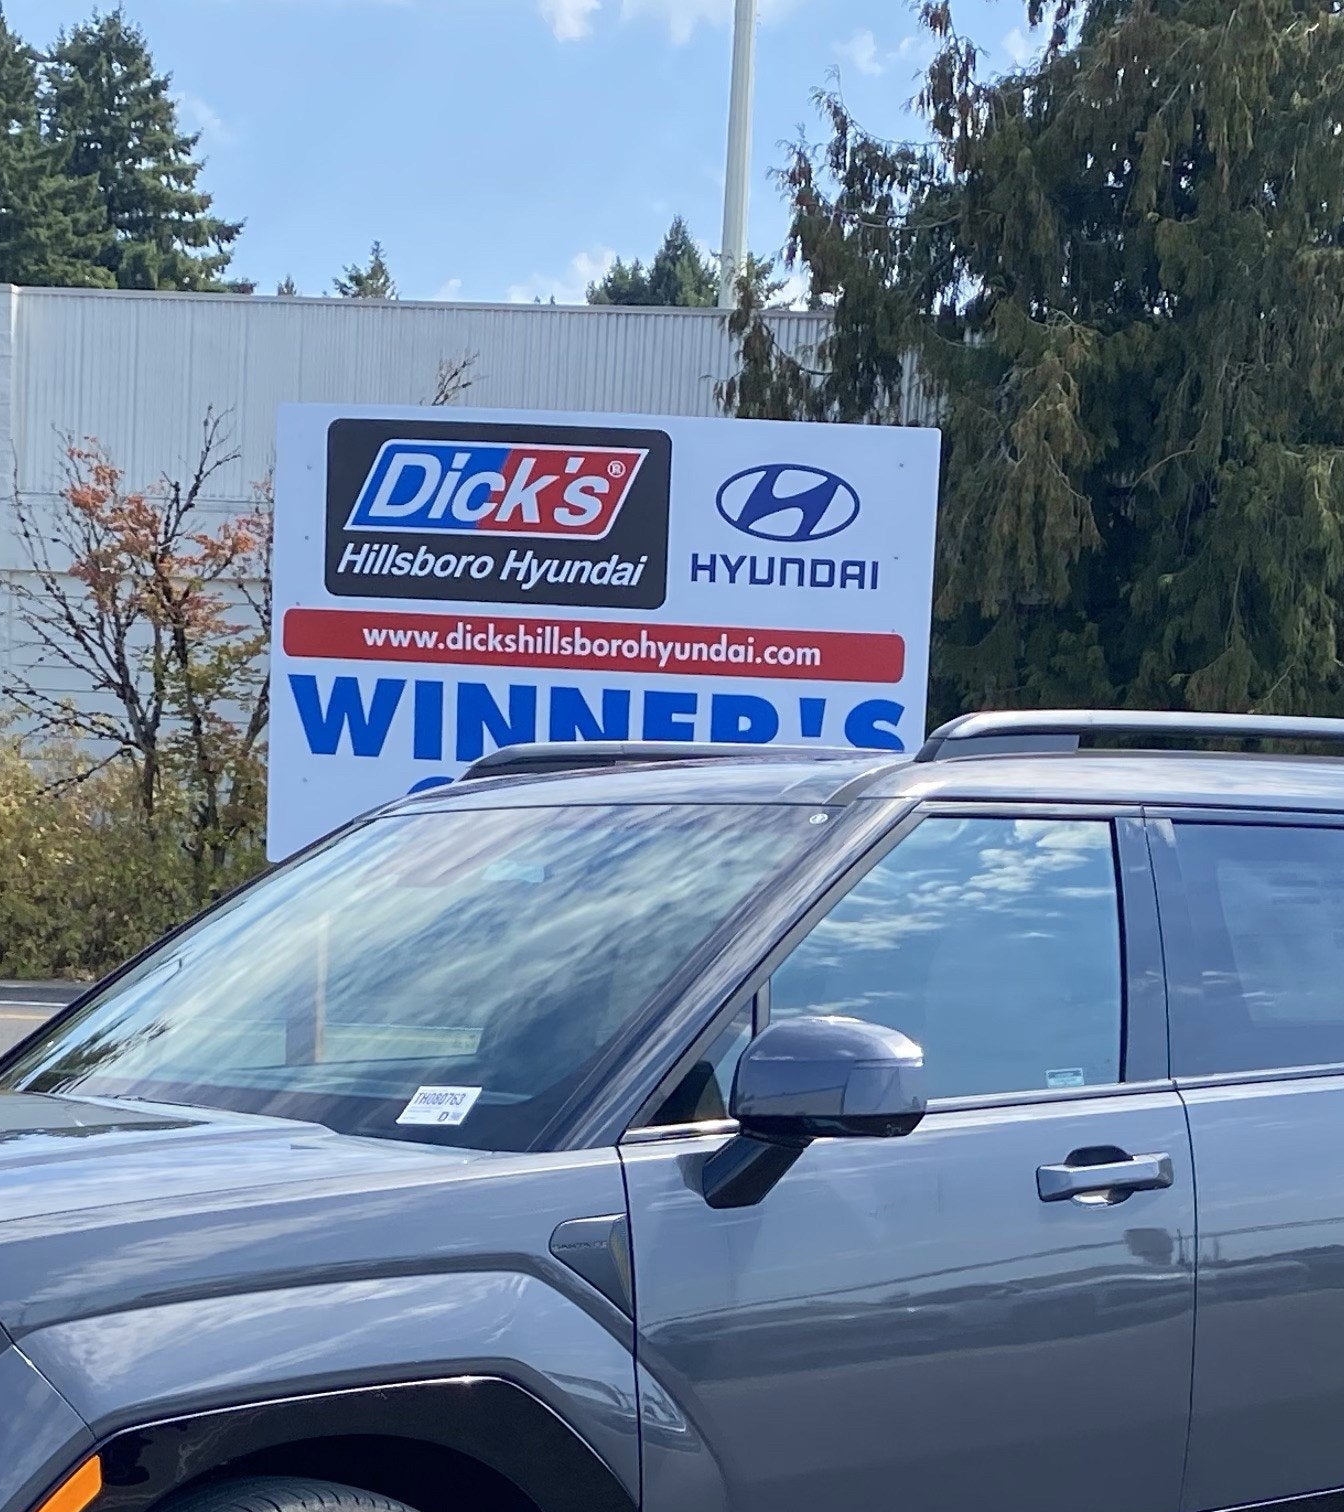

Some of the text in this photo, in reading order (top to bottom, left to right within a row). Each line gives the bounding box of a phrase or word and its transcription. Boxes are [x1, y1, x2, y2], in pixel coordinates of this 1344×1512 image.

[337, 543, 648, 590] Hillsboro Hyundai
[691, 553, 879, 590] HYUNDAI
[362, 622, 822, 667] www.dickshillsborohyundai.com
